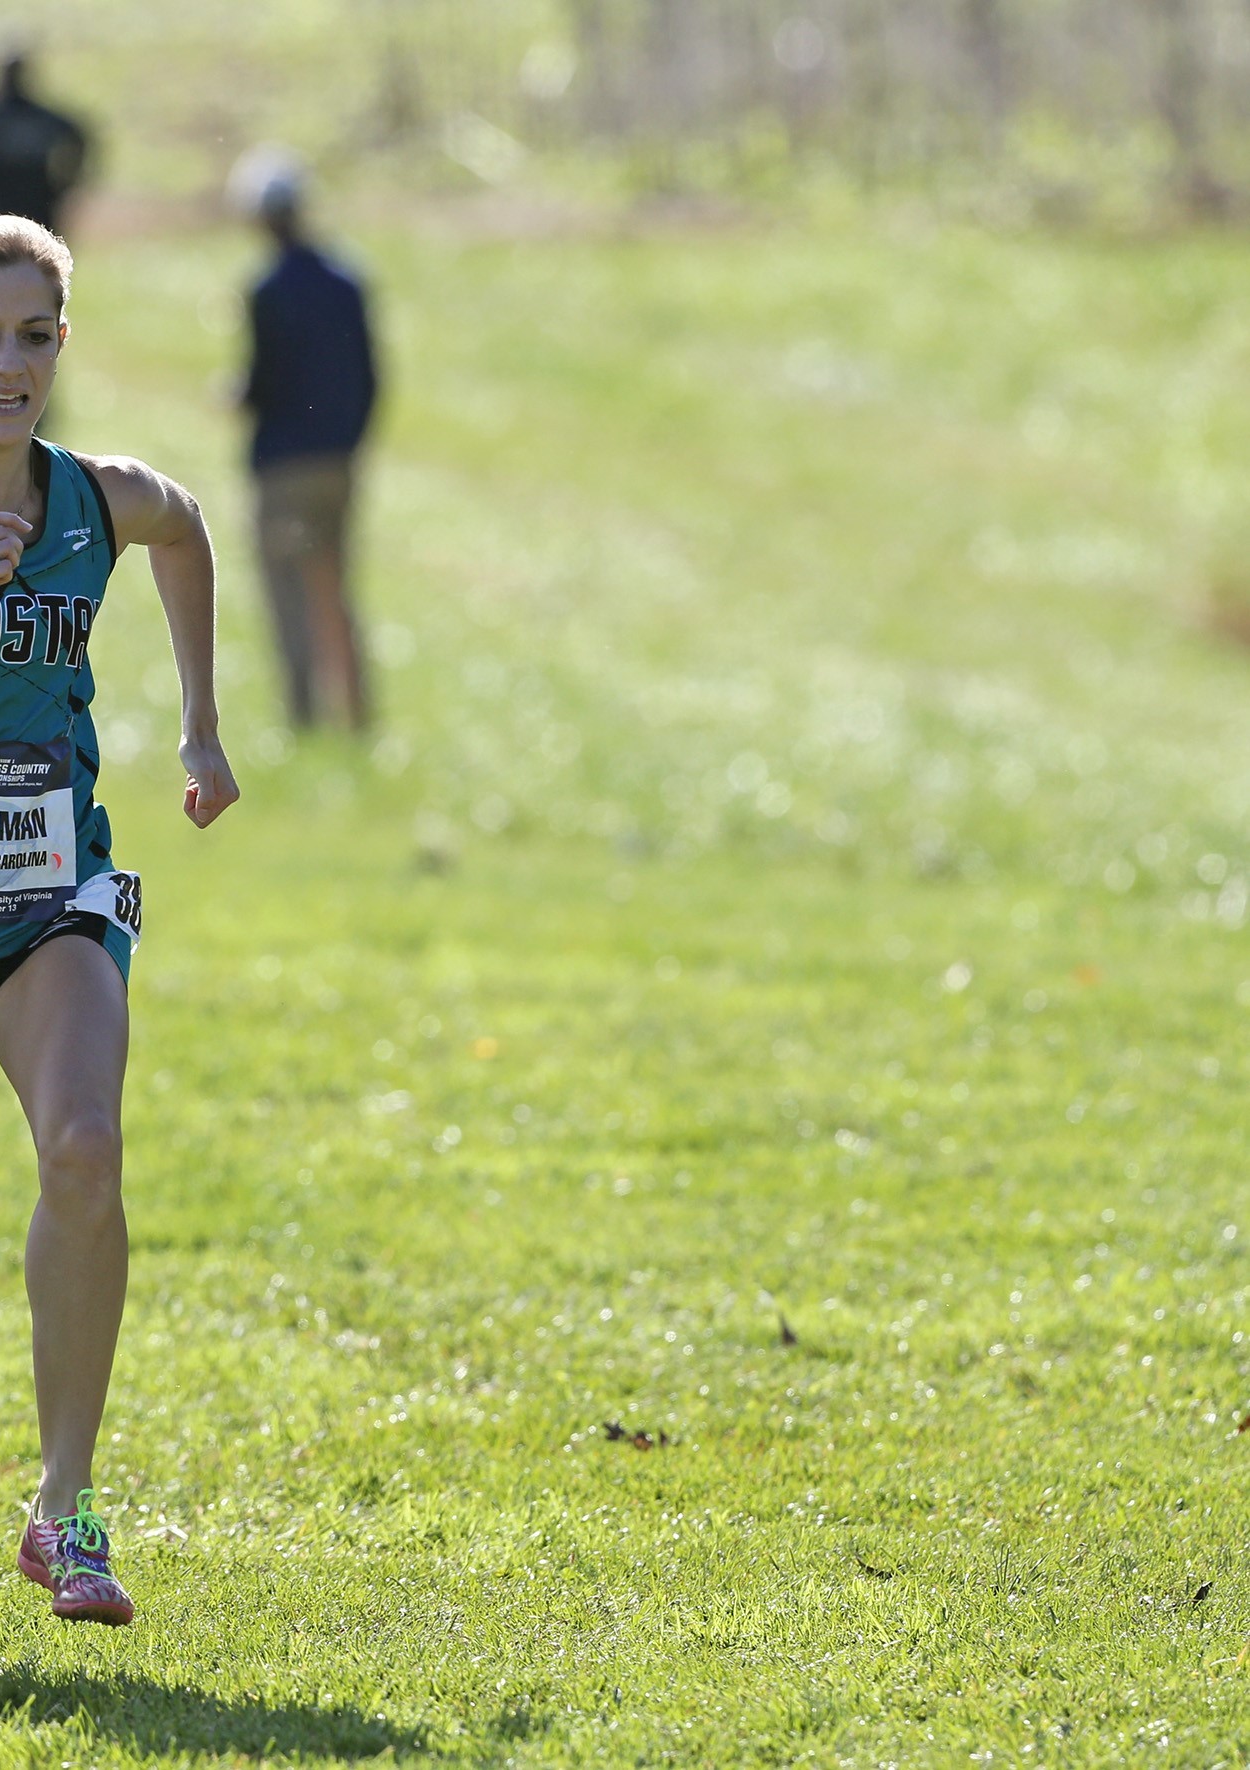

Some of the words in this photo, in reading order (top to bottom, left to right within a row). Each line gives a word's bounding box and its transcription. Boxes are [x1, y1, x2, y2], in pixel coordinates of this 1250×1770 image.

[10, 763, 51, 775] COUNTRY
[14, 894, 23, 902] of
[22, 892, 53, 902] Virginia
[8, 904, 17, 912] 13
[68, 1547, 98, 1570] LYNX
